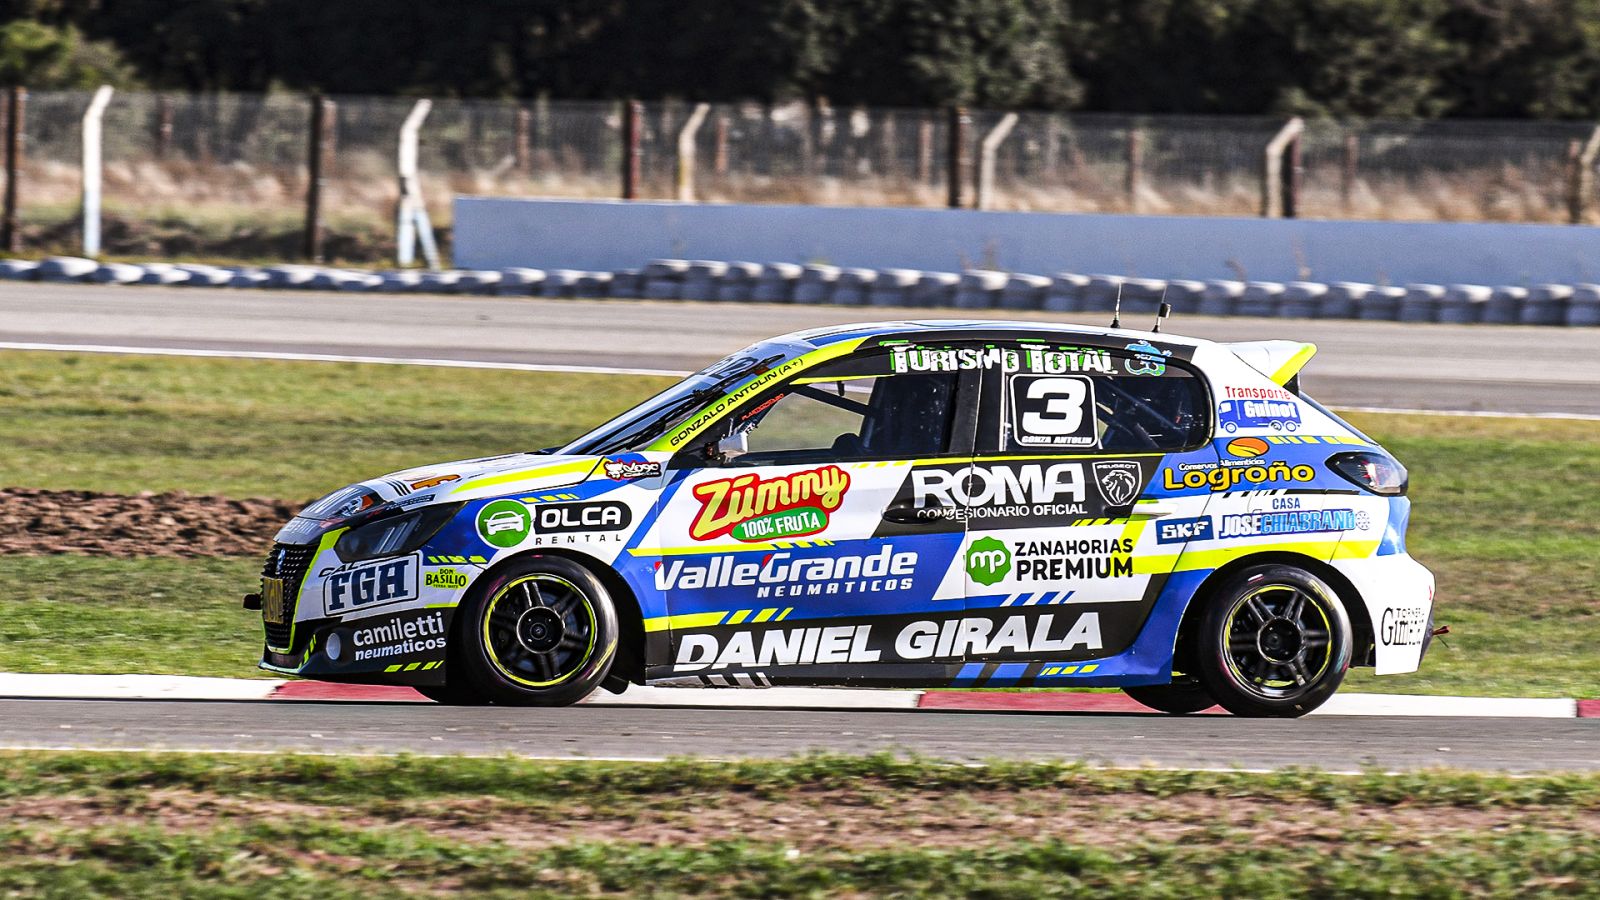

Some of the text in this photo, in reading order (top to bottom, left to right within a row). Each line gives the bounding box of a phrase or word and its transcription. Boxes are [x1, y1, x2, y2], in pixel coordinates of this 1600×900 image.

[884, 343, 1118, 374] TURISMO TOTAL
[670, 403, 726, 447] GONZALO
[727, 371, 778, 406] ANTOLIN
[779, 358, 803, 376] (A+)
[1225, 386, 1291, 400] Transporte
[1022, 378, 1087, 435] 3
[1243, 400, 1298, 418] Guinot
[911, 463, 1086, 508] ROMA
[1163, 461, 1316, 491] Logroño
[916, 503, 1088, 521] CONCESIONARIO OFICIAL
[1272, 498, 1301, 510] CASA
[541, 506, 622, 529] OLCA
[741, 511, 821, 538] 100% FRUTA
[535, 534, 622, 546] RENTAL
[1161, 521, 1209, 540] SKF
[1014, 538, 1134, 558] ZANAHORIAS
[425, 573, 467, 587] BASILIO
[654, 544, 918, 591] ValleGrande
[1015, 557, 1134, 582] PREMIUM
[328, 560, 410, 611] FGH
[757, 578, 913, 598] NEUMATICOS
[353, 612, 445, 646] camiletti
[355, 636, 447, 661] neumaticos
[673, 612, 1104, 672] DANIEL GIRALA
